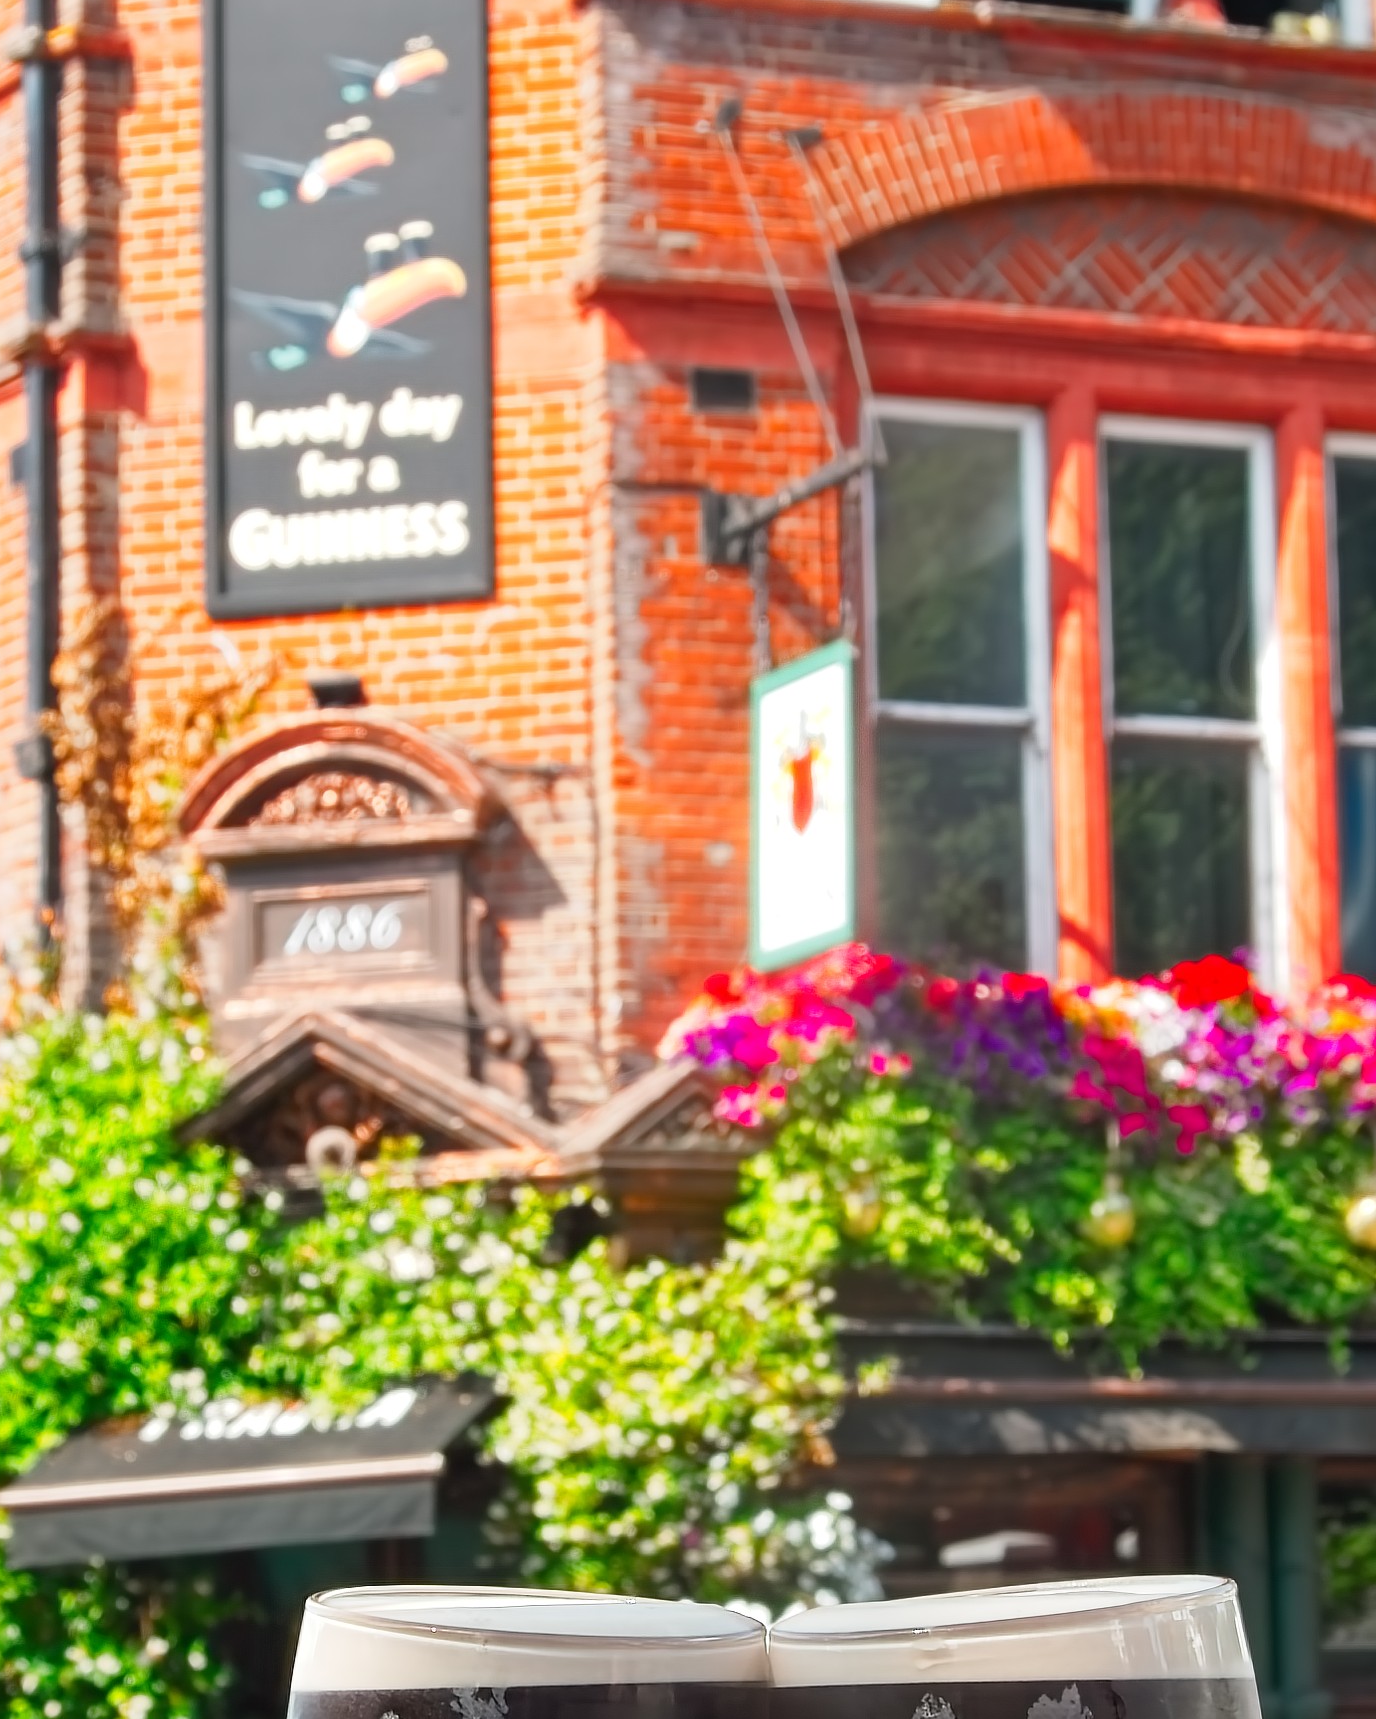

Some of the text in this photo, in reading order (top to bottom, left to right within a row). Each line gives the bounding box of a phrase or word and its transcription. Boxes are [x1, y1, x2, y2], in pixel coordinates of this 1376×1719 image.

[234, 387, 463, 449] Lovely day
[297, 450, 401, 498] for a
[229, 501, 470, 571] GUINNESS
[283, 901, 407, 957] 1886
